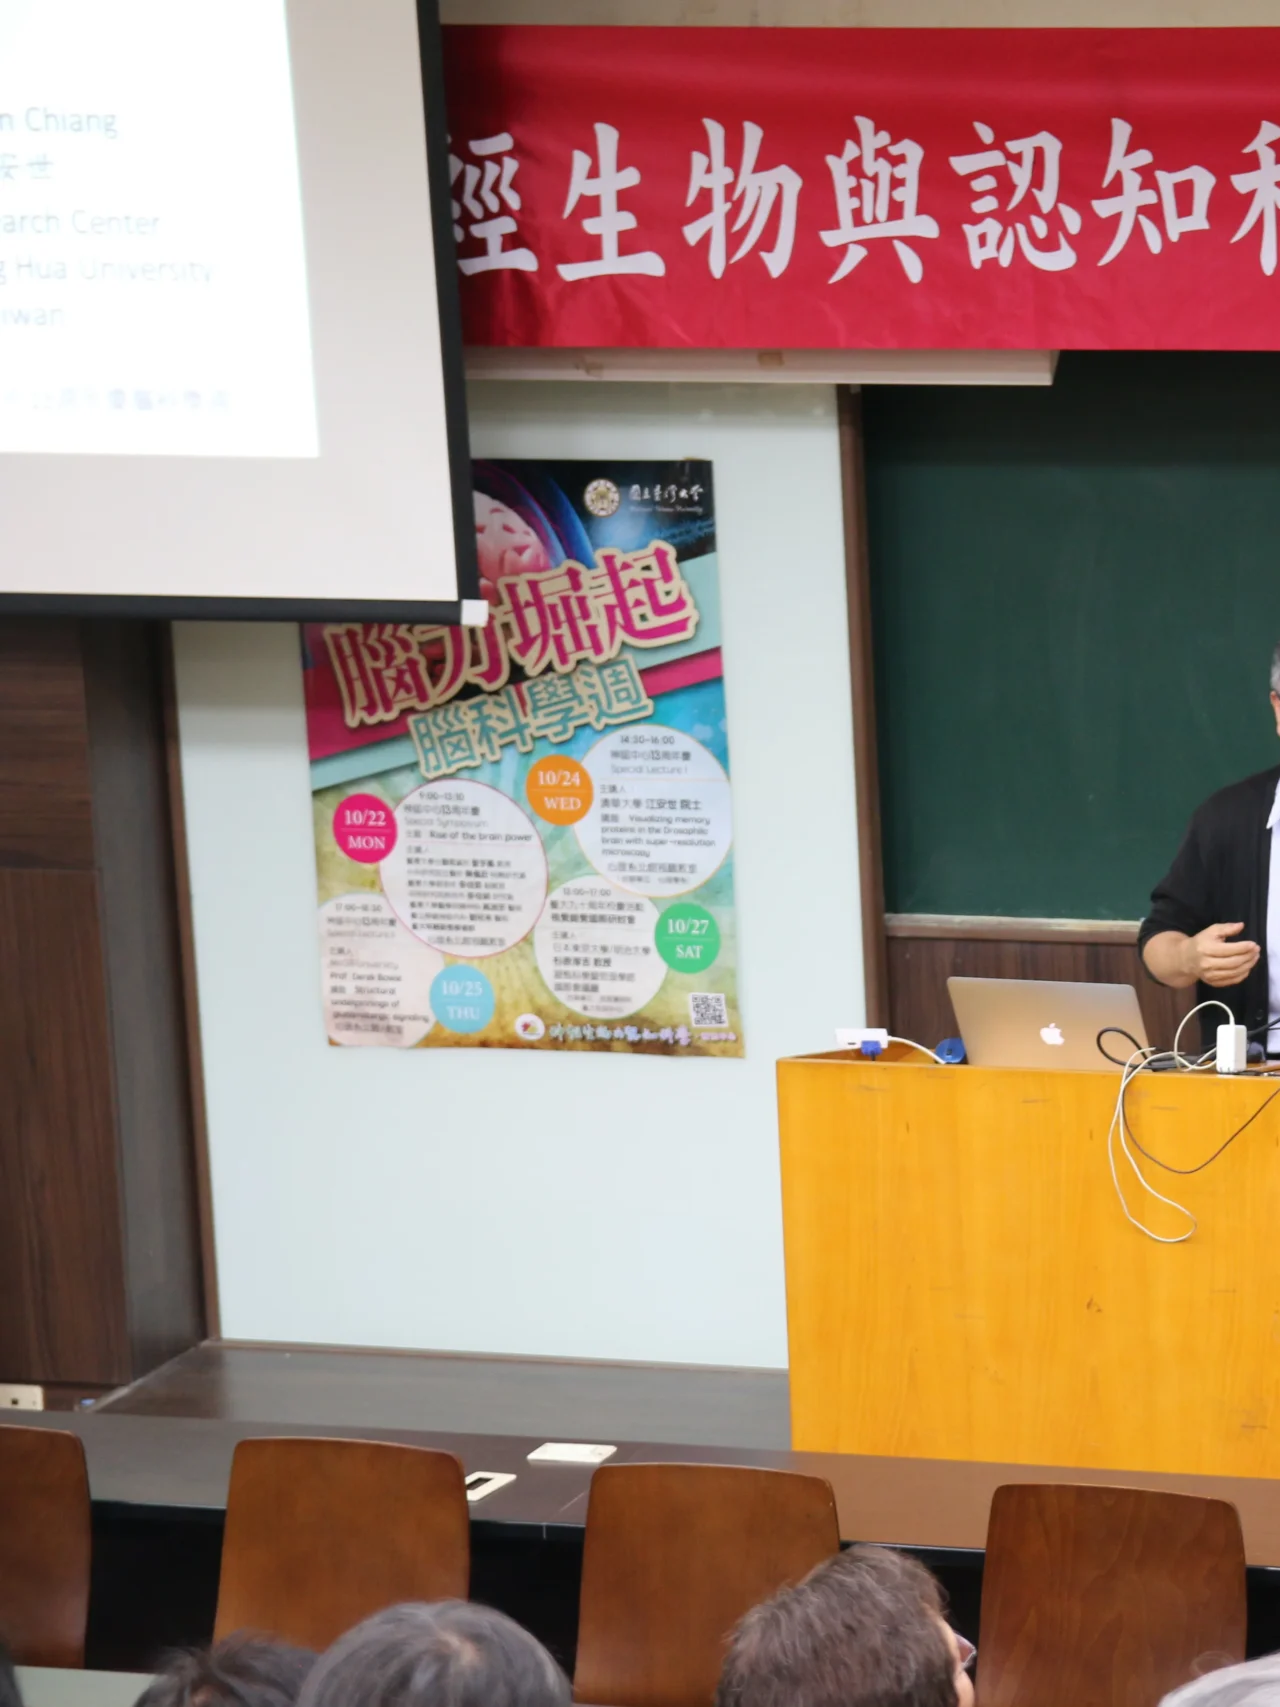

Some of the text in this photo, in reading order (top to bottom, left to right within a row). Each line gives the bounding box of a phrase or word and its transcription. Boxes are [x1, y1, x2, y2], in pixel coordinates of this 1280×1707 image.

[24, 106, 118, 140] Chiang
[0, 206, 160, 235] arch Center
[16, 254, 68, 281] Hua
[79, 257, 214, 285] University
[411, 659, 651, 775] 腦科學週
[537, 770, 582, 789] 10/24
[543, 796, 582, 812] WED
[343, 809, 388, 827] 10/22
[675, 816, 711, 826] memory
[450, 831, 460, 840] of
[462, 831, 477, 841] the
[479, 833, 503, 842] brain
[505, 834, 533, 843] power
[648, 826, 661, 835] the
[347, 834, 387, 851] MON
[625, 837, 643, 846] with
[667, 918, 711, 935] 10/27
[675, 944, 703, 960] SAT
[441, 980, 484, 997] 10/25
[446, 1004, 481, 1021] THU
